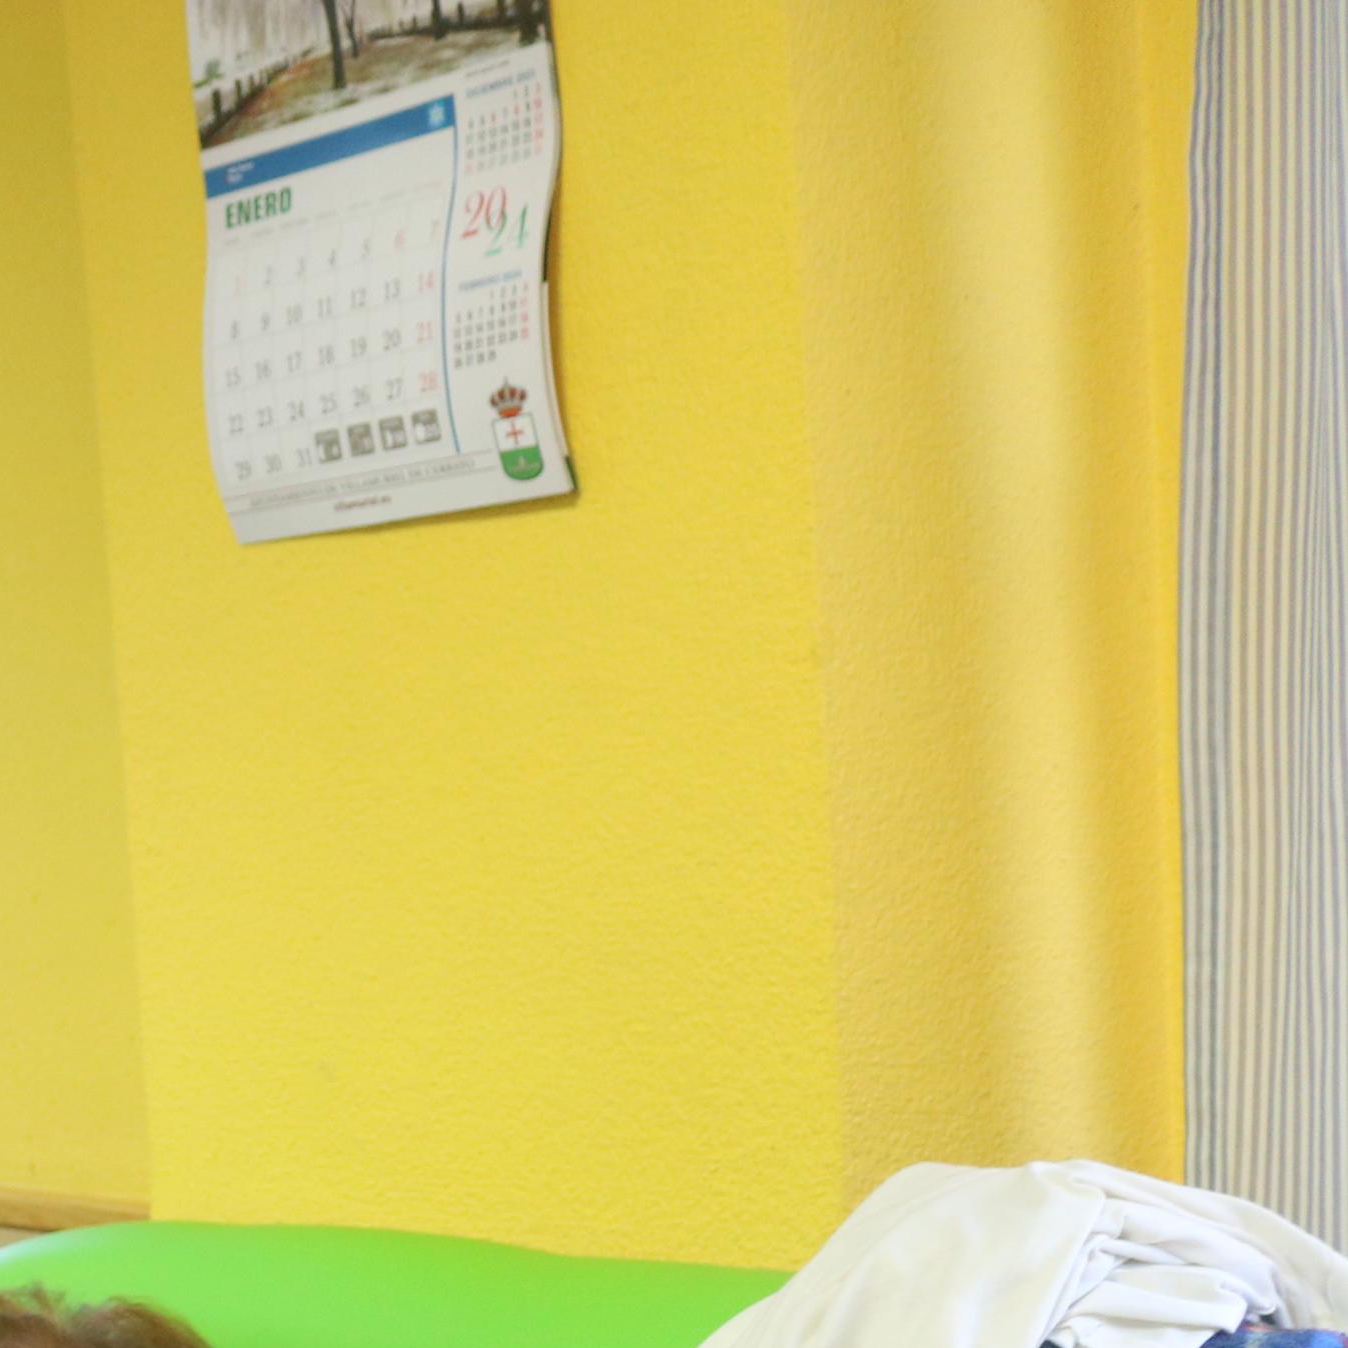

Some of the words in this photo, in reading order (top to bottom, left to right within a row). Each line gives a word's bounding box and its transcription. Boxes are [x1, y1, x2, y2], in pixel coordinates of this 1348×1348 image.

[225, 187, 292, 229] ENERO
[318, 296, 332, 319] 11
[350, 288, 367, 310] 12
[384, 278, 401, 302] 13
[418, 270, 434, 294] 14
[350, 335, 367, 358] 19
[382, 328, 401, 351] 20
[416, 321, 433, 344] 21
